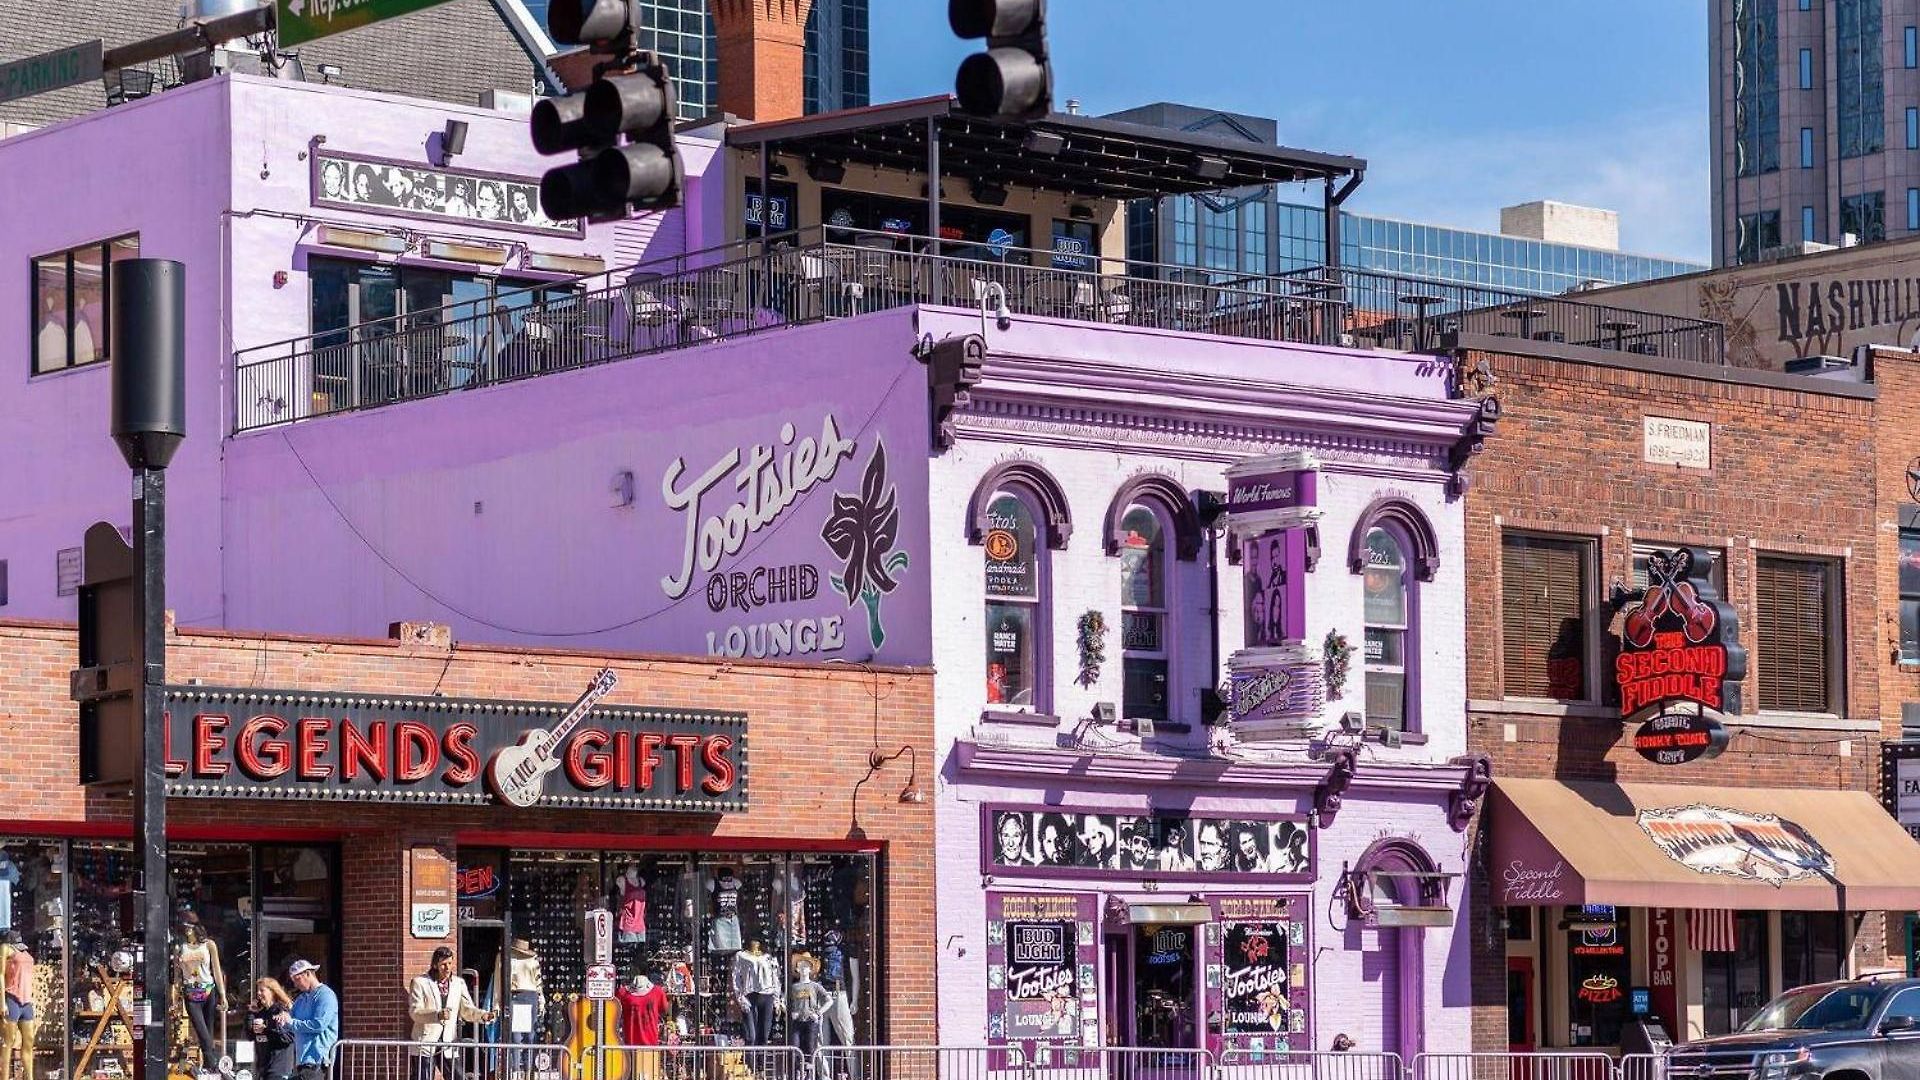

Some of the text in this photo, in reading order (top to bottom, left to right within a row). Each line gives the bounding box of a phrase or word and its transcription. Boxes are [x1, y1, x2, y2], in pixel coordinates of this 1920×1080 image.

[9, 48, 80, 98] PARKING
[752, 197, 779, 212] BD
[660, 413, 858, 601] Tootsies
[706, 563, 819, 614] ORCHID
[705, 616, 846, 660] LOUNGE
[1616, 646, 1725, 685] SECOND
[1621, 674, 1720, 717] FIDDLE
[164, 710, 732, 796] LEGENDS GIFTS
[1634, 731, 1709, 748] HONKY TONK
[457, 866, 493, 894] PEN
[1503, 860, 1562, 881] Second
[1504, 880, 1562, 902] Fiddle
[1021, 928, 1056, 945] BUD
[1016, 944, 1062, 961] LIGHT
[1008, 964, 1074, 1001] Tootsies
[1224, 962, 1288, 999] Tootsies
[1653, 971, 1673, 986] BAR
[1578, 989, 1622, 1003] PIZZA
[1633, 995, 1648, 1003] ATM
